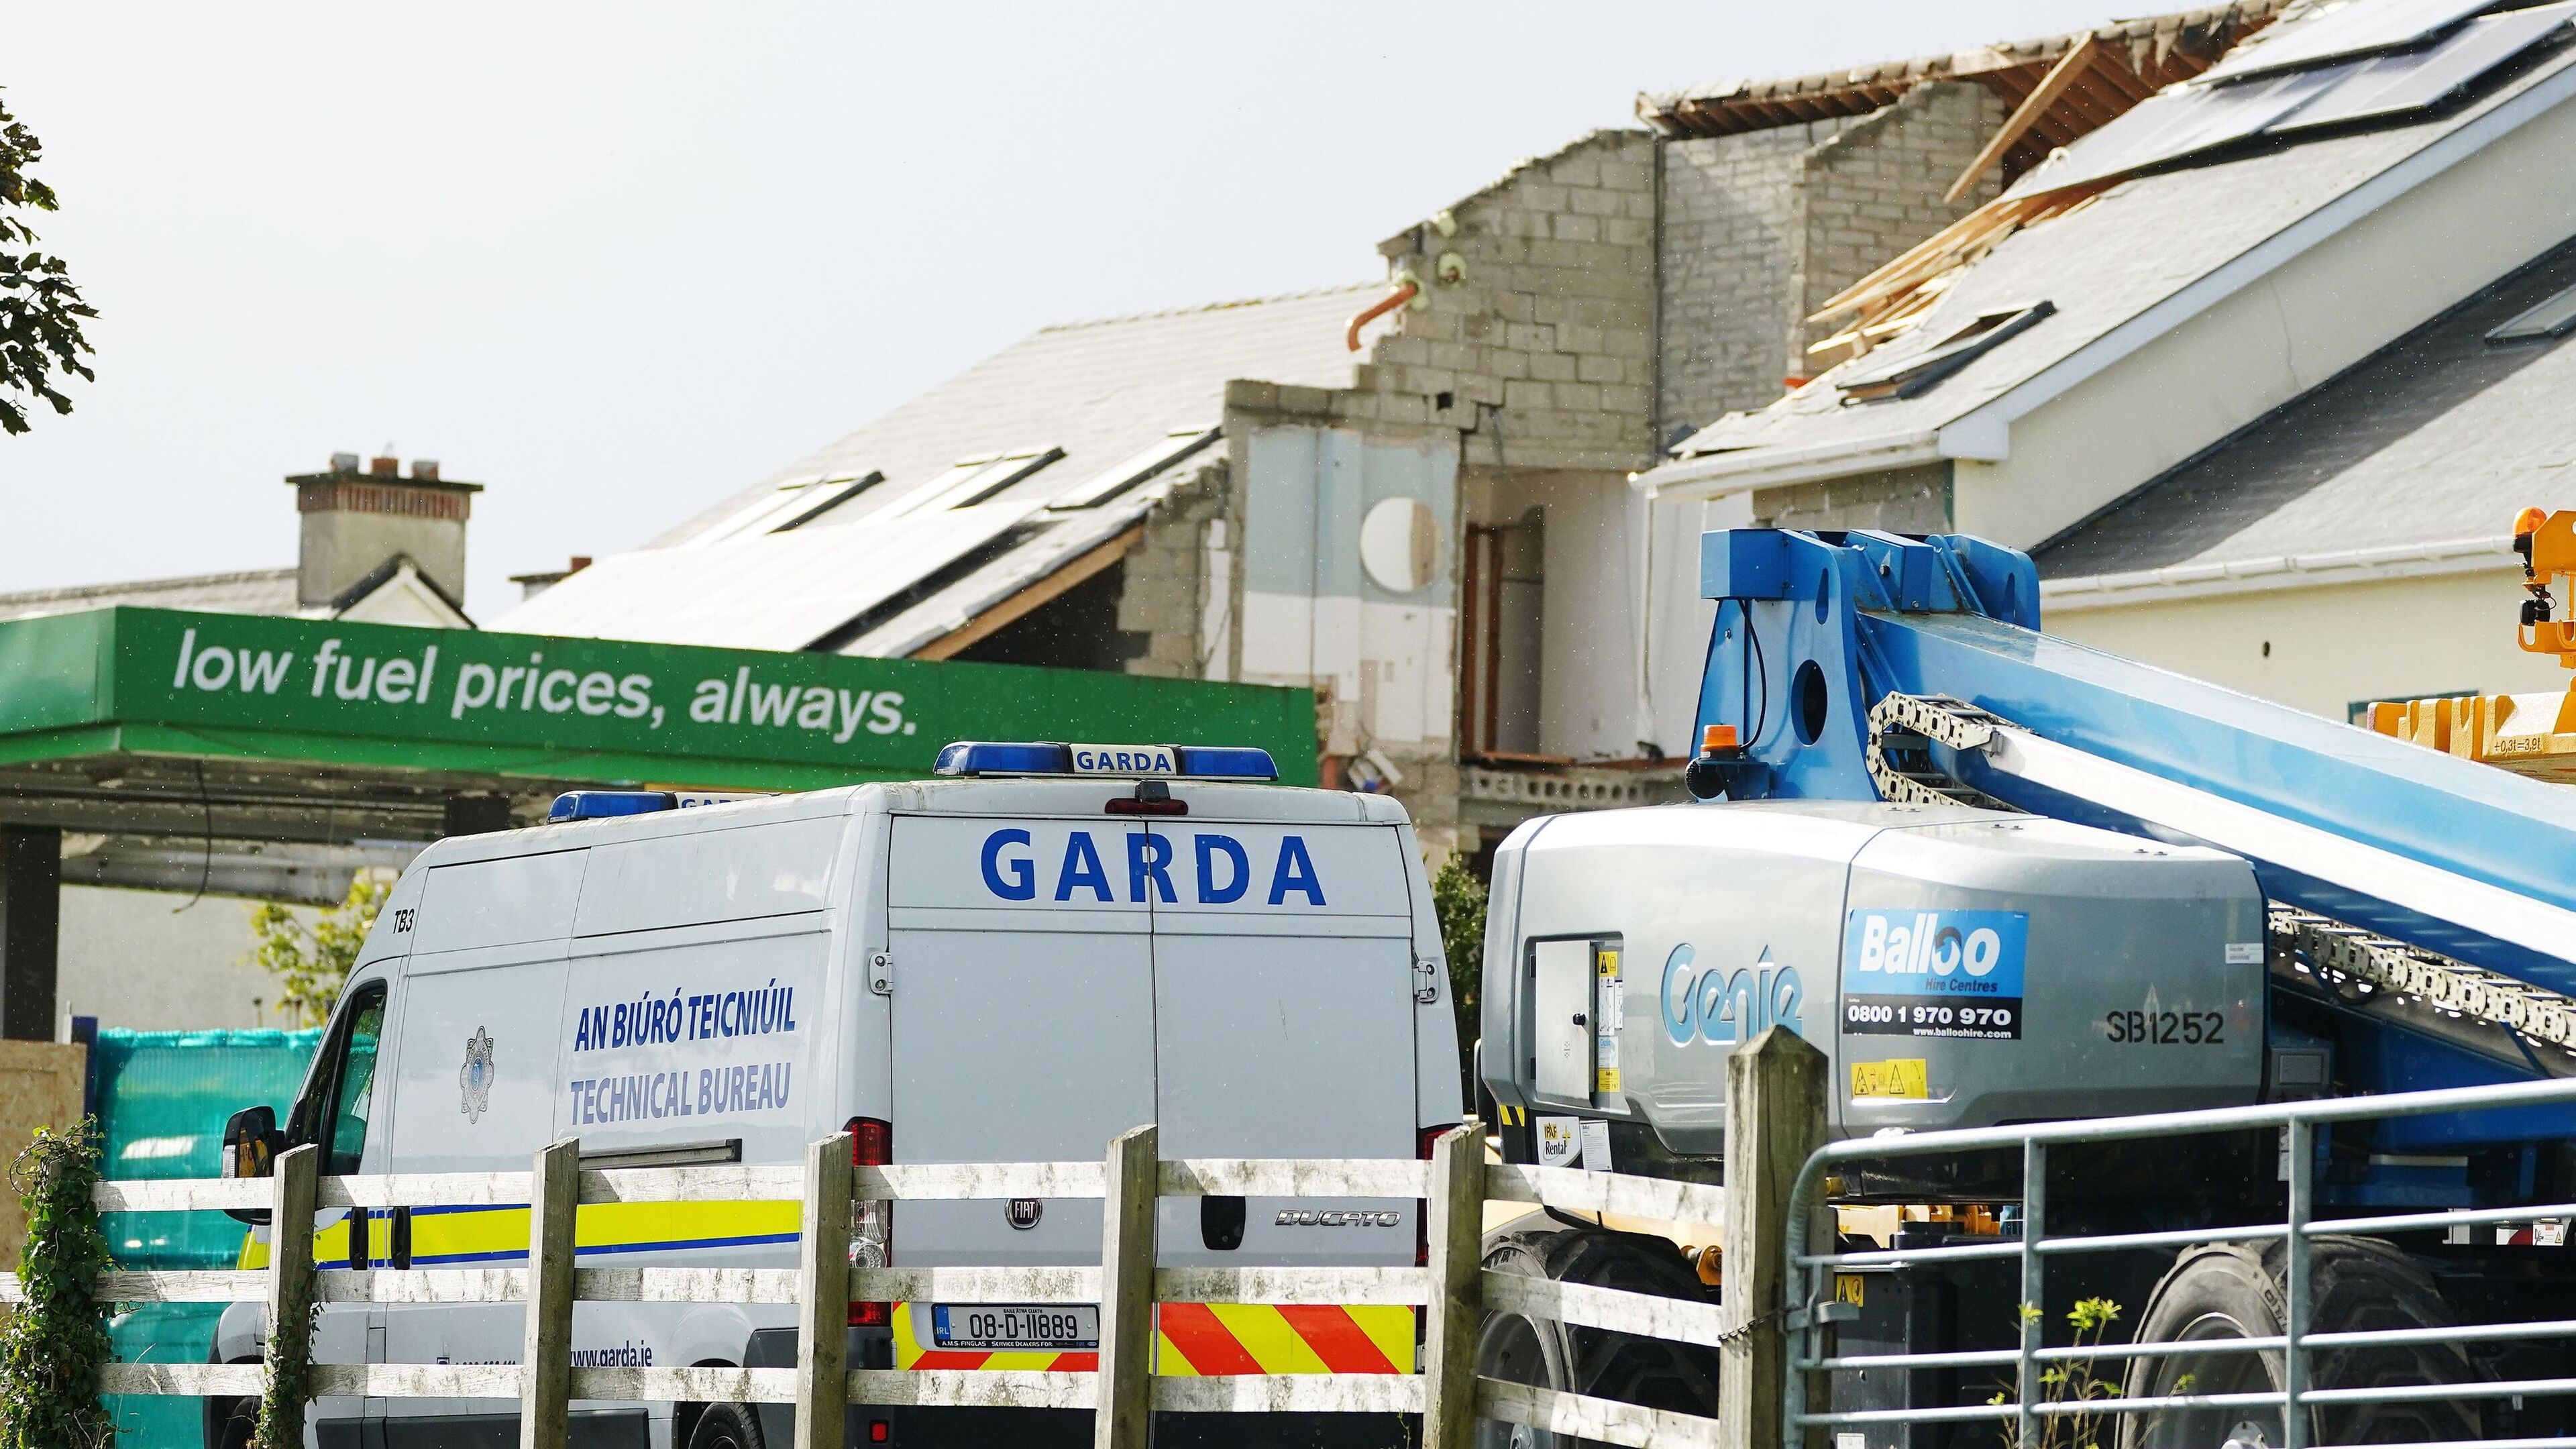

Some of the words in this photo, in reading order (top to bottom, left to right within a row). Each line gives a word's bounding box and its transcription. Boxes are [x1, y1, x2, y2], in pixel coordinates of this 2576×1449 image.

[174, 629, 292, 694] low
[311, 639, 438, 704] fuel
[451, 652, 665, 729] prices,
[689, 665, 916, 743] always.
[1077, 751, 1171, 771] GARDA
[981, 828, 1326, 906] GARDA
[392, 908, 415, 934] TB3
[1661, 944, 1804, 1048] Genie
[1925, 979, 1946, 991] Hire
[1949, 979, 1998, 993] Centres
[574, 1005, 609, 1052] AN
[611, 986, 683, 1049] BIÚRÓ
[688, 977, 796, 1040] TEICNIÚIL
[1848, 1005, 1892, 1023] 0800
[1898, 1006, 1907, 1023] 1
[1913, 1006, 1953, 1024] 970
[1960, 1008, 2012, 1026] 970
[2106, 1010, 2224, 1044] SB1252
[1913, 1027, 2012, 1038] www.balloohire.com
[570, 1071, 692, 1126] TECHNICAL
[698, 1062, 792, 1116] BUREAU
[1546, 1140, 1567, 1155] Rental
[1014, 1201, 1035, 1218] FIAT
[1275, 1210, 1401, 1227] DUCATO
[936, 1327, 950, 1335] IRL
[969, 1313, 1078, 1339] 08-D-11889
[570, 1340, 652, 1367] ww.garda.ie
